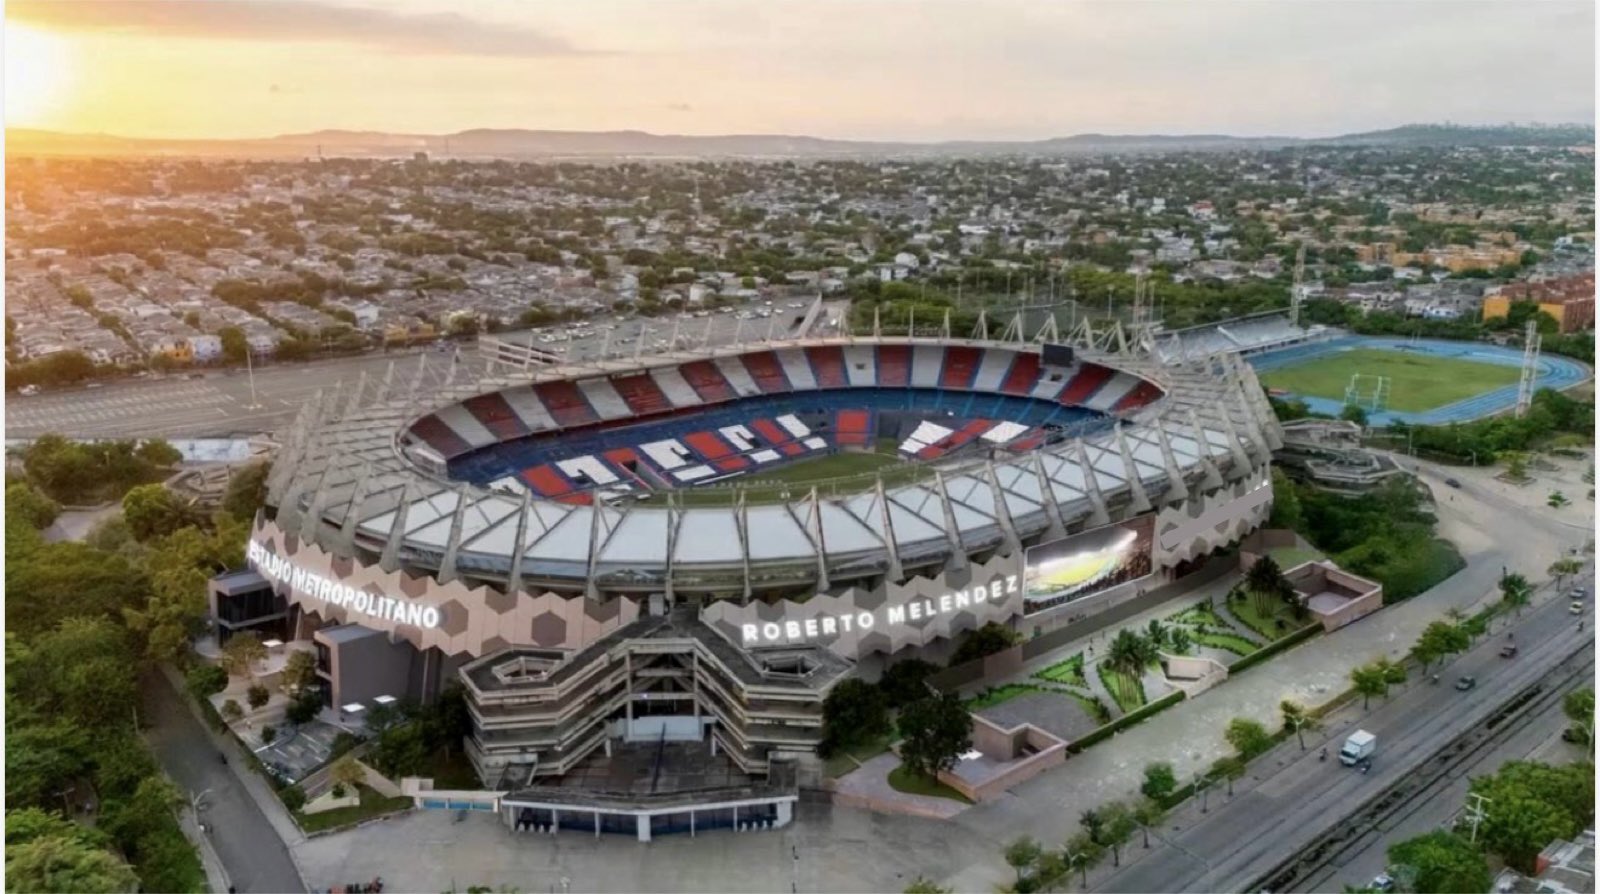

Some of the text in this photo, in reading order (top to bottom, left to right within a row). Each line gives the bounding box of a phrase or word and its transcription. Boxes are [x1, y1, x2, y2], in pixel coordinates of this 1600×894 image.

[249, 539, 439, 628] ESTADIO METROPOLITANO
[742, 574, 1018, 641] ROBERTO MELENDEZ
